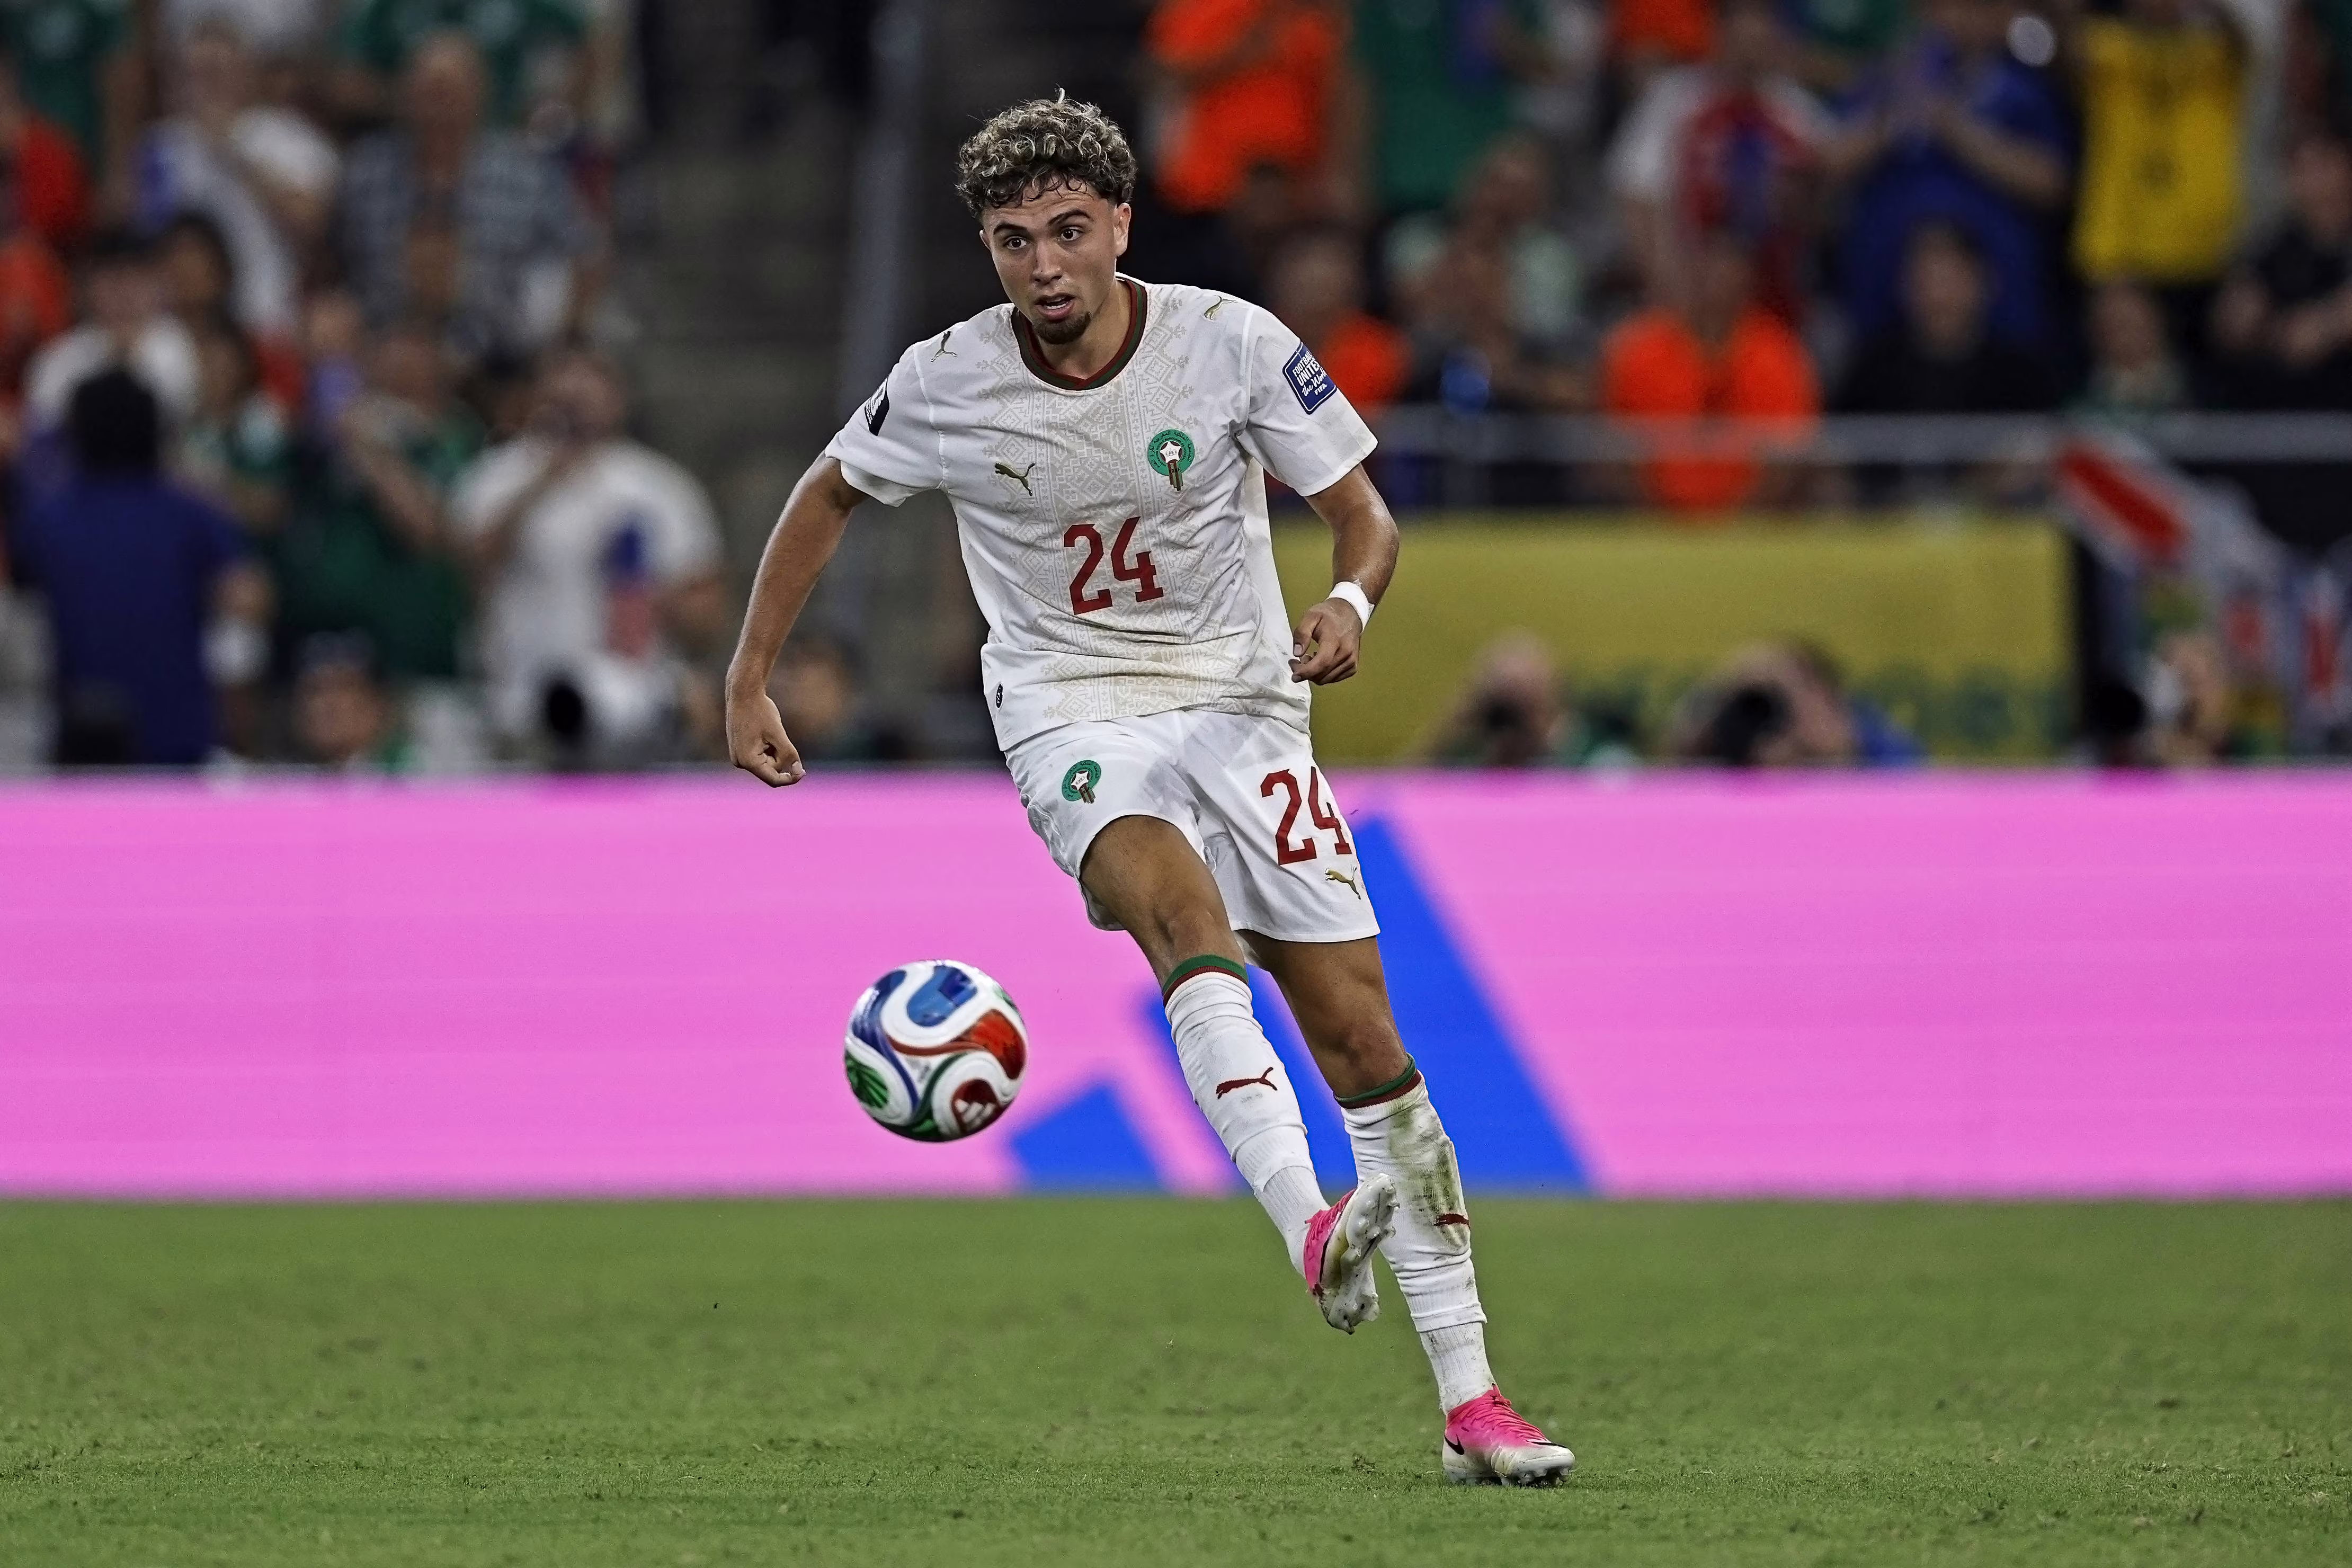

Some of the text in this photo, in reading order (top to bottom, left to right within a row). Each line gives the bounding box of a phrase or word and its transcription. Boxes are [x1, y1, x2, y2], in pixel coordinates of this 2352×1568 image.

[1293, 350, 1312, 377] FOOTBALL
[1296, 357, 1320, 386] UNITES
[1302, 385, 1313, 397] the
[1314, 383, 1328, 395] FIFA
[1063, 516, 1164, 615] 24
[1260, 765, 1352, 866] 24
